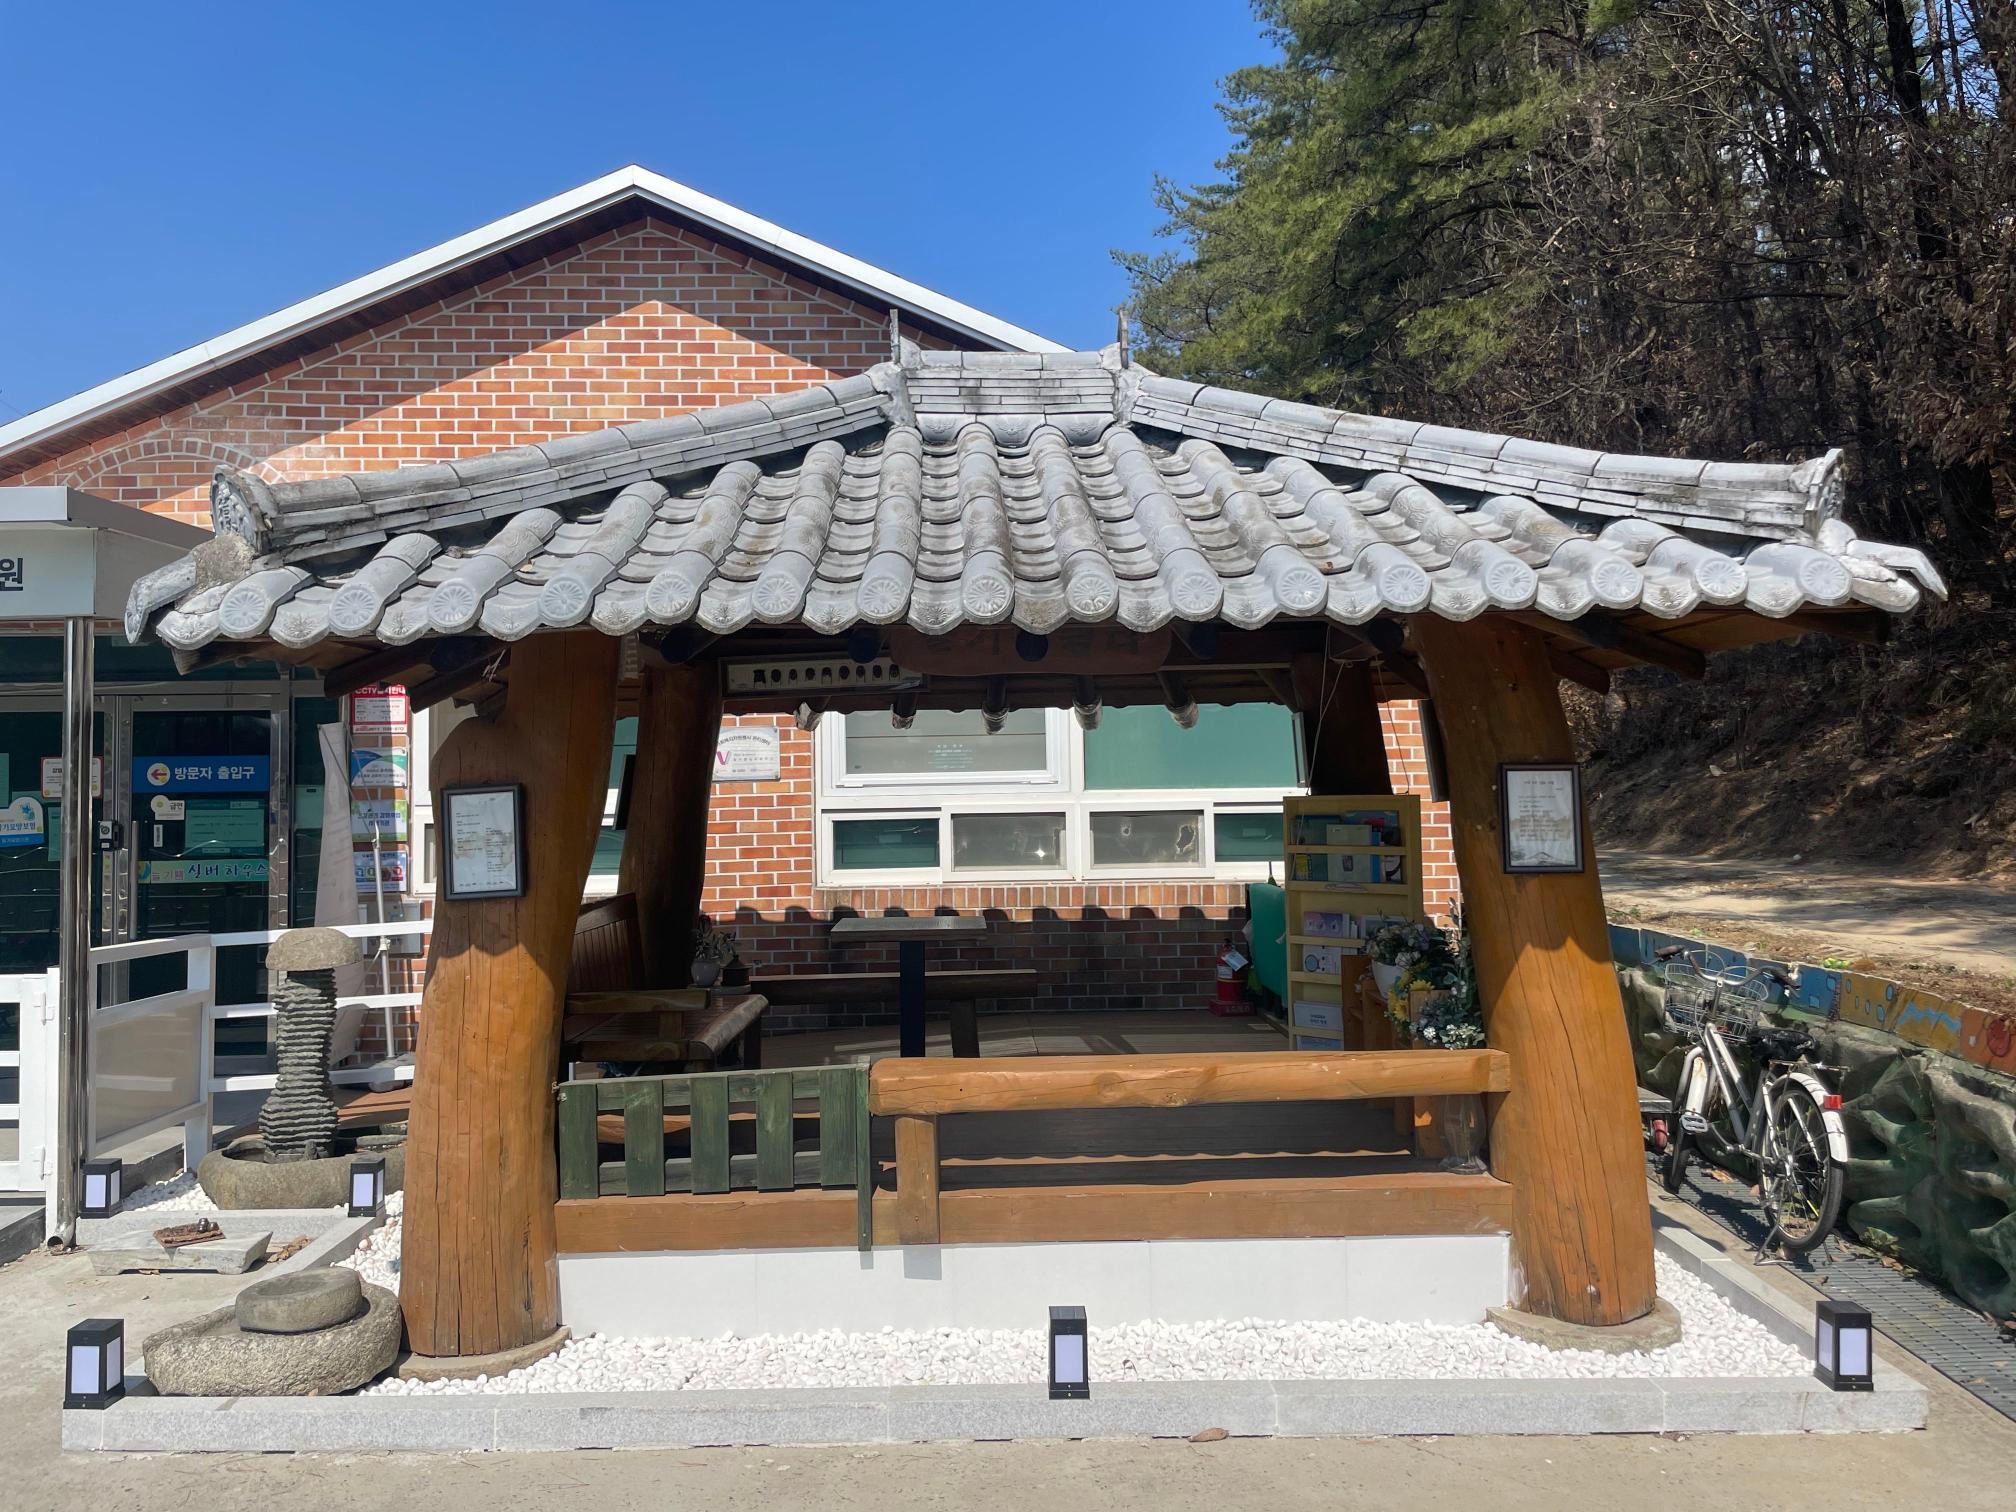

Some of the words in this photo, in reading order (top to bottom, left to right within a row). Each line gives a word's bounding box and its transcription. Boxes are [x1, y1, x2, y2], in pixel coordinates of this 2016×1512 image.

[0, 557, 24, 592] 원
[174, 766, 213, 780] 방문자
[217, 766, 256, 780] 출입구
